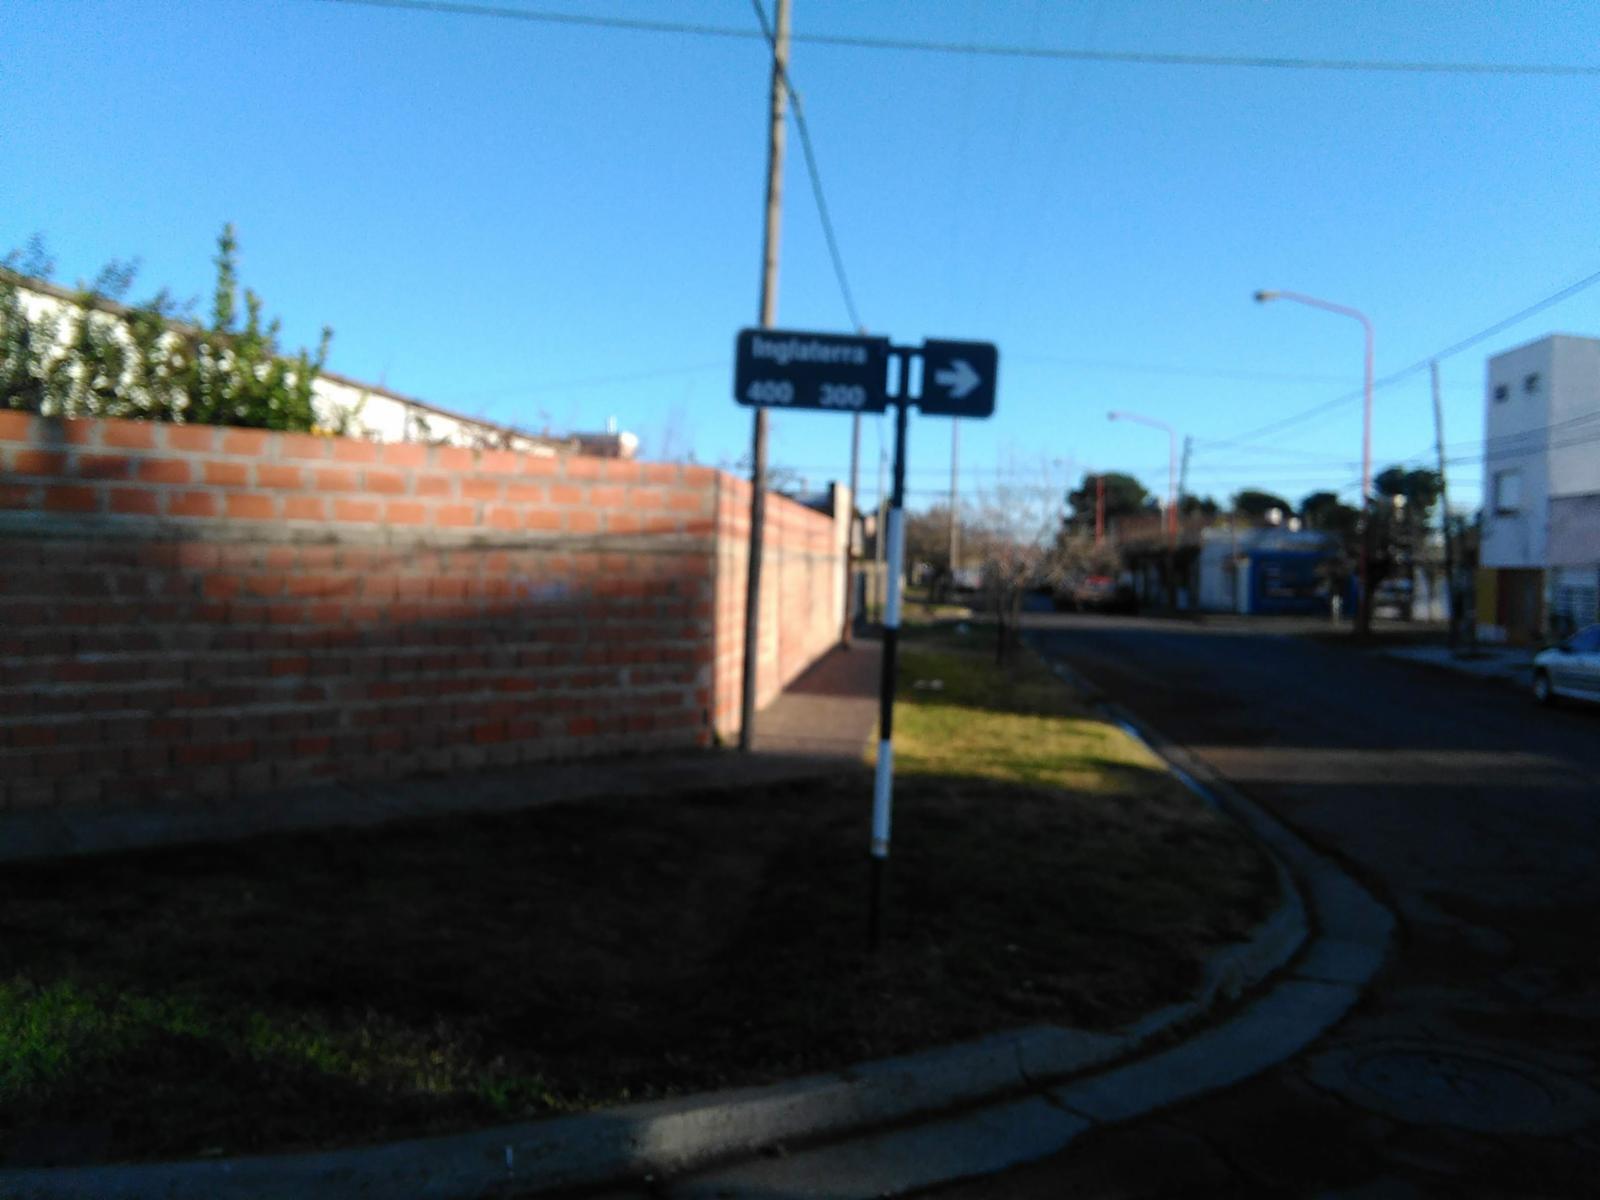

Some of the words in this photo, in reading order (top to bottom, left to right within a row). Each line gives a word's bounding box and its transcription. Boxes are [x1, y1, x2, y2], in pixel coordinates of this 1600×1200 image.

[752, 337, 867, 364] Inglaterra
[747, 381, 794, 403] 400
[819, 384, 866, 407] 300
